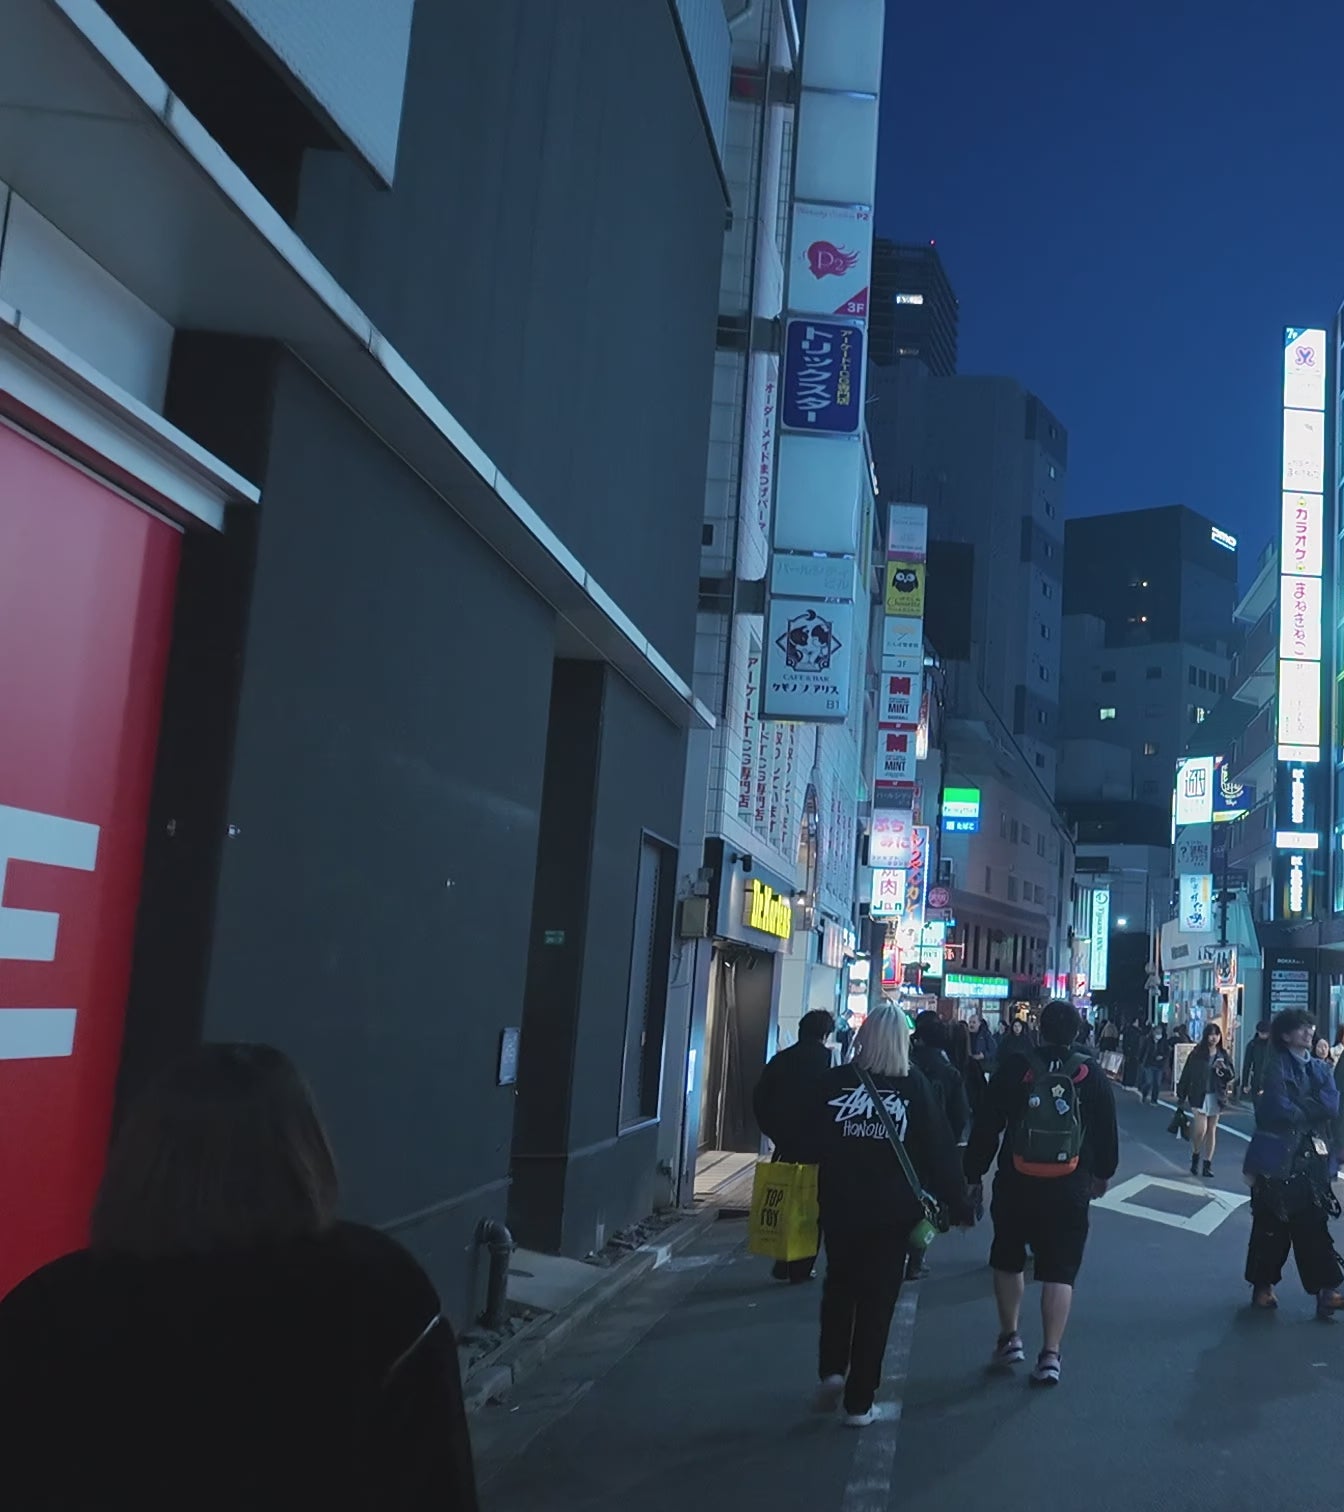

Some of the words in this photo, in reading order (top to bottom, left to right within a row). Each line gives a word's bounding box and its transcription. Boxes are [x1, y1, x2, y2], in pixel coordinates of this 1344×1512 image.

[847, 302, 865, 313] 3F
[1294, 508, 1308, 561] カラオケ
[888, 703, 909, 715] MINT
[884, 761, 906, 772] MINT
[764, 1188, 784, 1208] TOP
